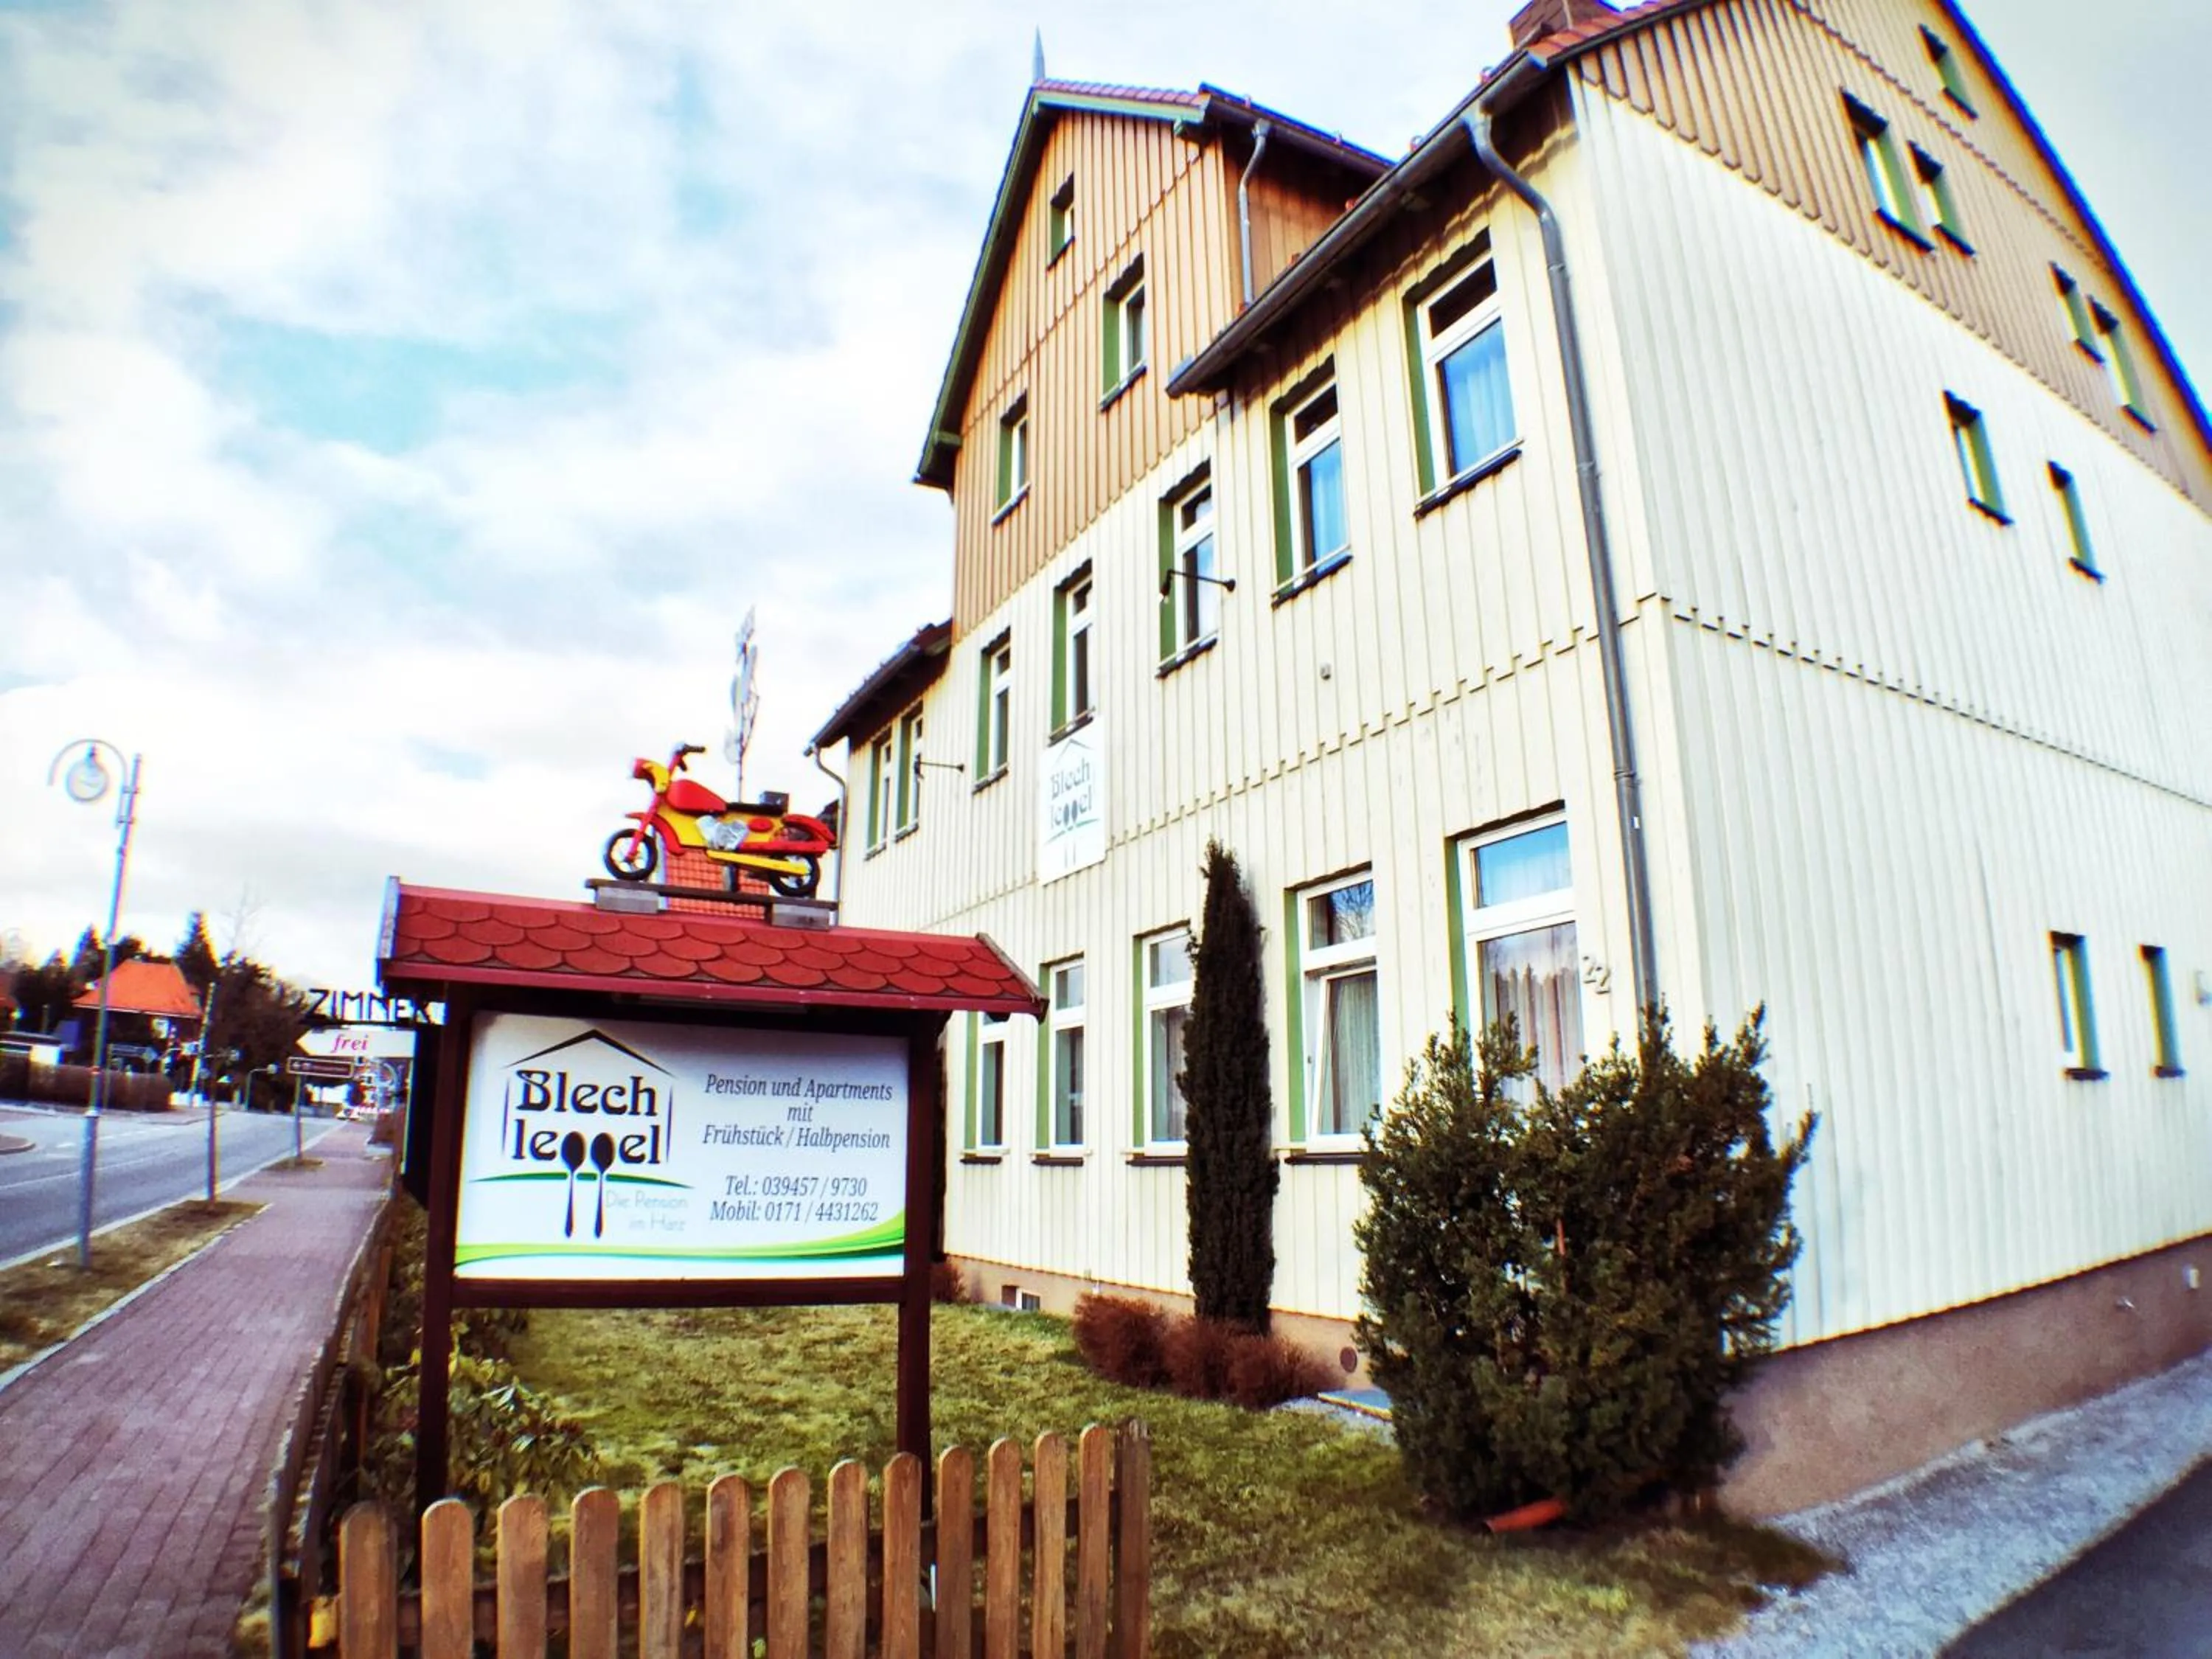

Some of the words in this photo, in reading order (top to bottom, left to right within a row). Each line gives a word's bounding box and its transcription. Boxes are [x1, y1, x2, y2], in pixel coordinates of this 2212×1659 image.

[1582, 955, 1611, 995] 22
[330, 1034, 369, 1054] frei
[515, 1070, 658, 1116] Blech
[705, 1074, 766, 1096] Pension
[771, 1077, 801, 1097] und
[804, 1079, 893, 1103] Apartments
[787, 1102, 814, 1122] mit
[703, 1124, 785, 1147] Frühstück
[796, 1127, 891, 1153] Halbpension
[725, 1175, 758, 1197] Tel.:
[762, 1176, 819, 1197] 039457
[831, 1178, 868, 1197] 9730
[710, 1200, 762, 1222] Mobil:
[765, 1201, 801, 1222] 0171
[815, 1202, 879, 1222] 4431262
